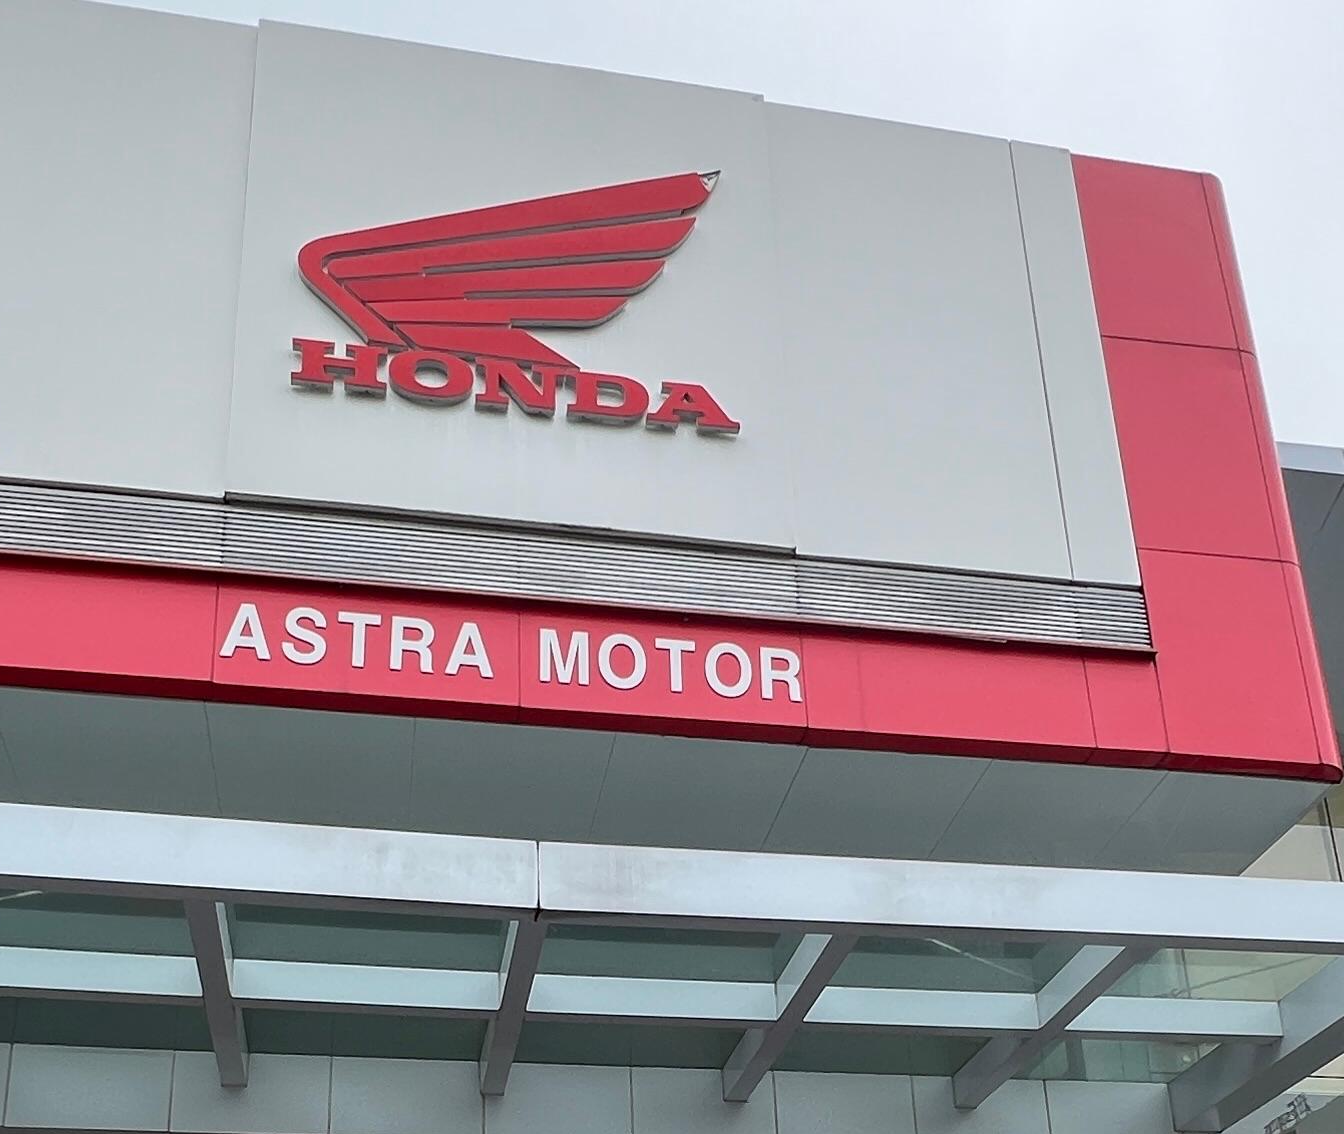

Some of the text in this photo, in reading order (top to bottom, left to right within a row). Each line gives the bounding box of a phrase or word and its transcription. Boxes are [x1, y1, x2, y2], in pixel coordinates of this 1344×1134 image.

[290, 337, 741, 436] HONDA
[219, 602, 804, 704] ASTRA MOTOR
